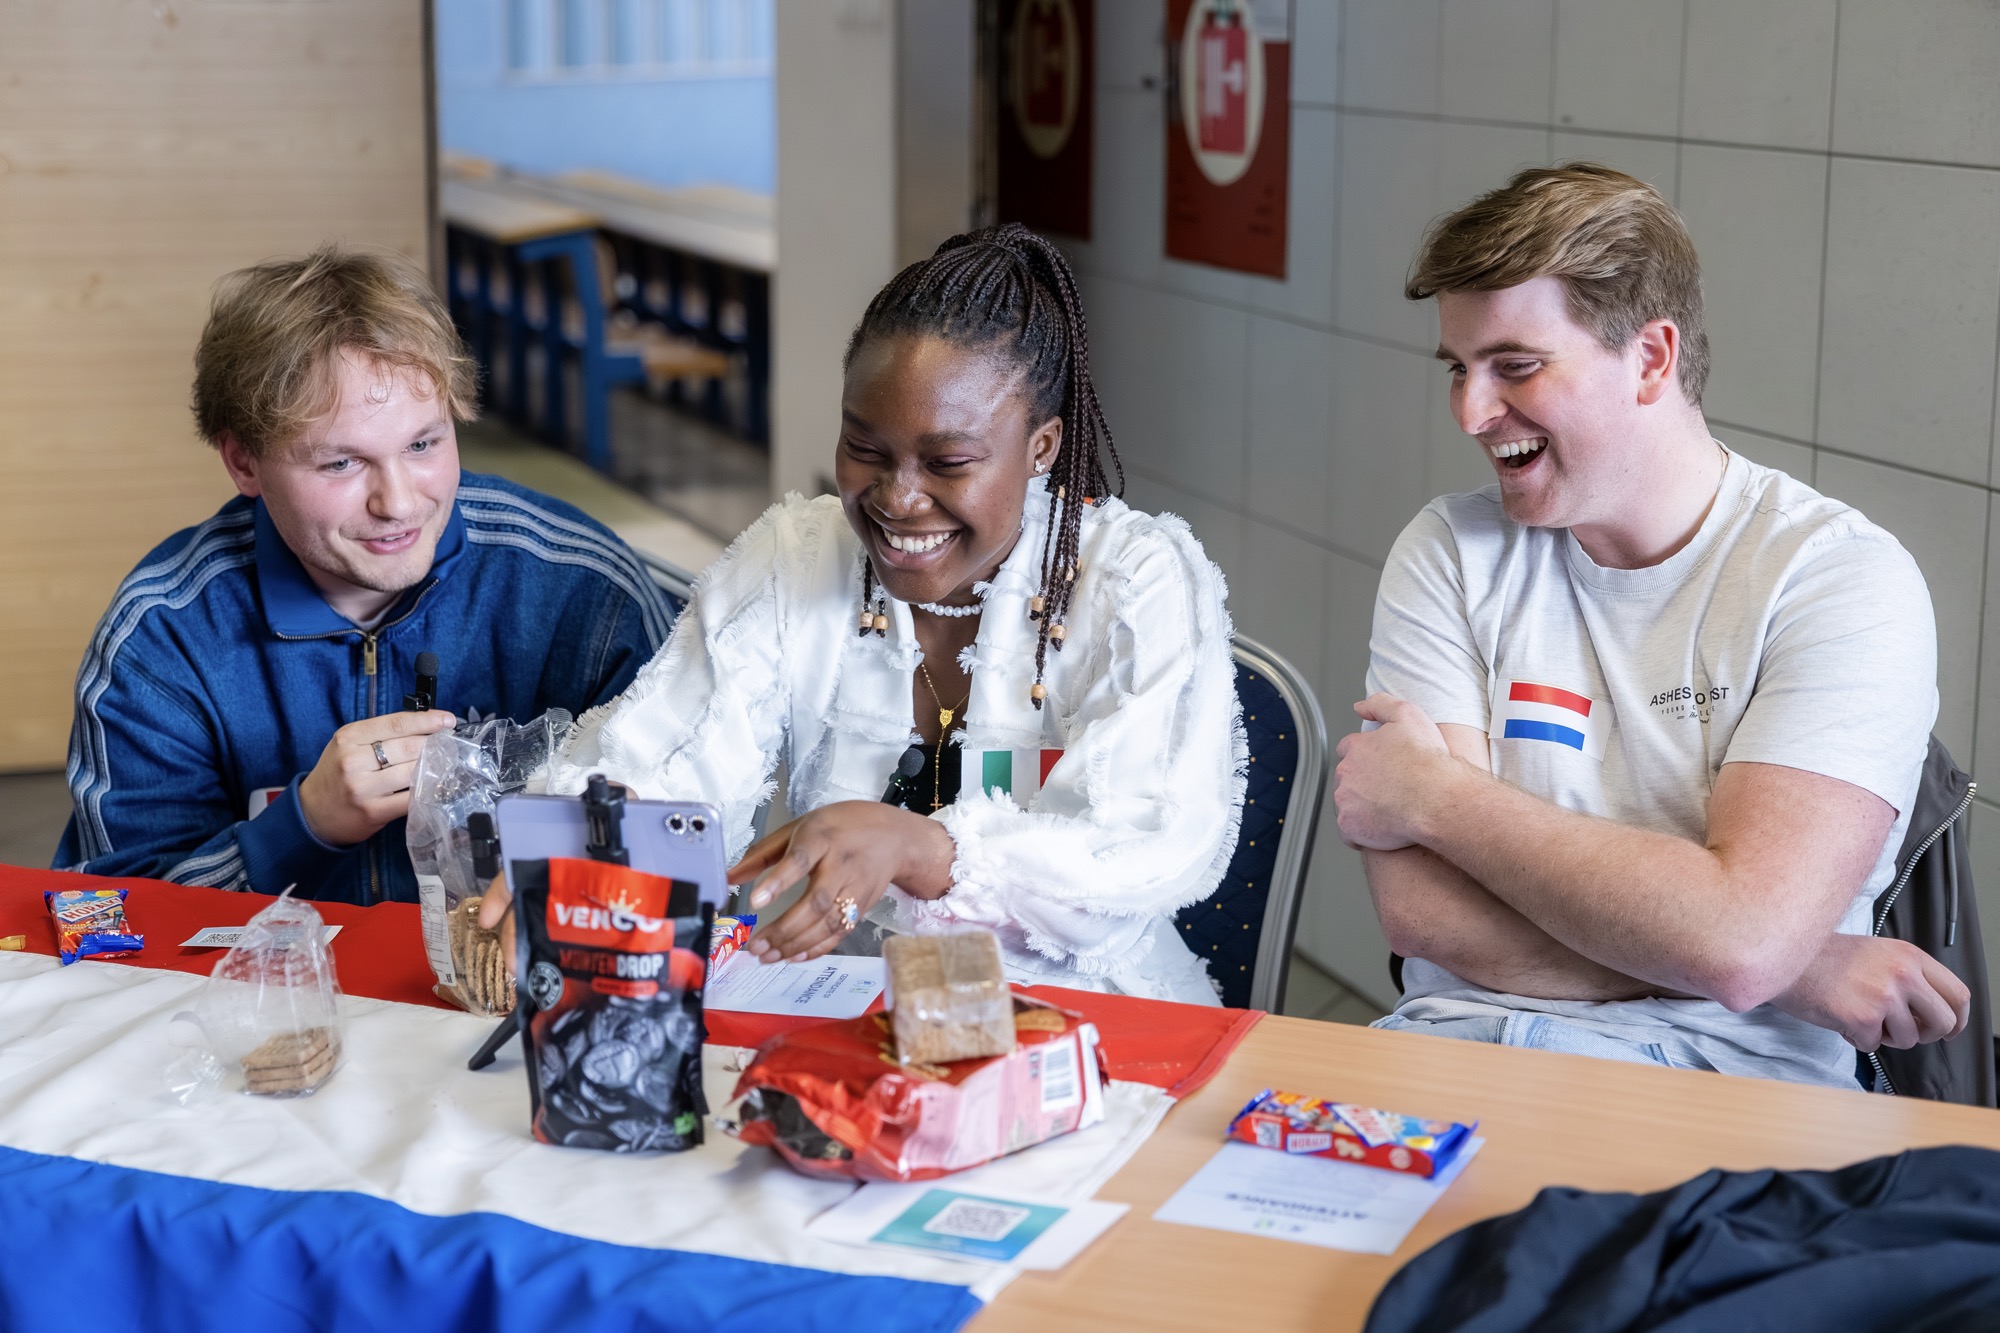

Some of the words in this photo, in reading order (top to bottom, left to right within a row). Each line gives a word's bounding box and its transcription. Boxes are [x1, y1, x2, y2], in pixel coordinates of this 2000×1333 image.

[1649, 686, 1692, 706] ASHES
[62, 897, 122, 919] HORALKY
[554, 901, 664, 933] VENCO
[794, 966, 838, 1004] ATTENDANCE
